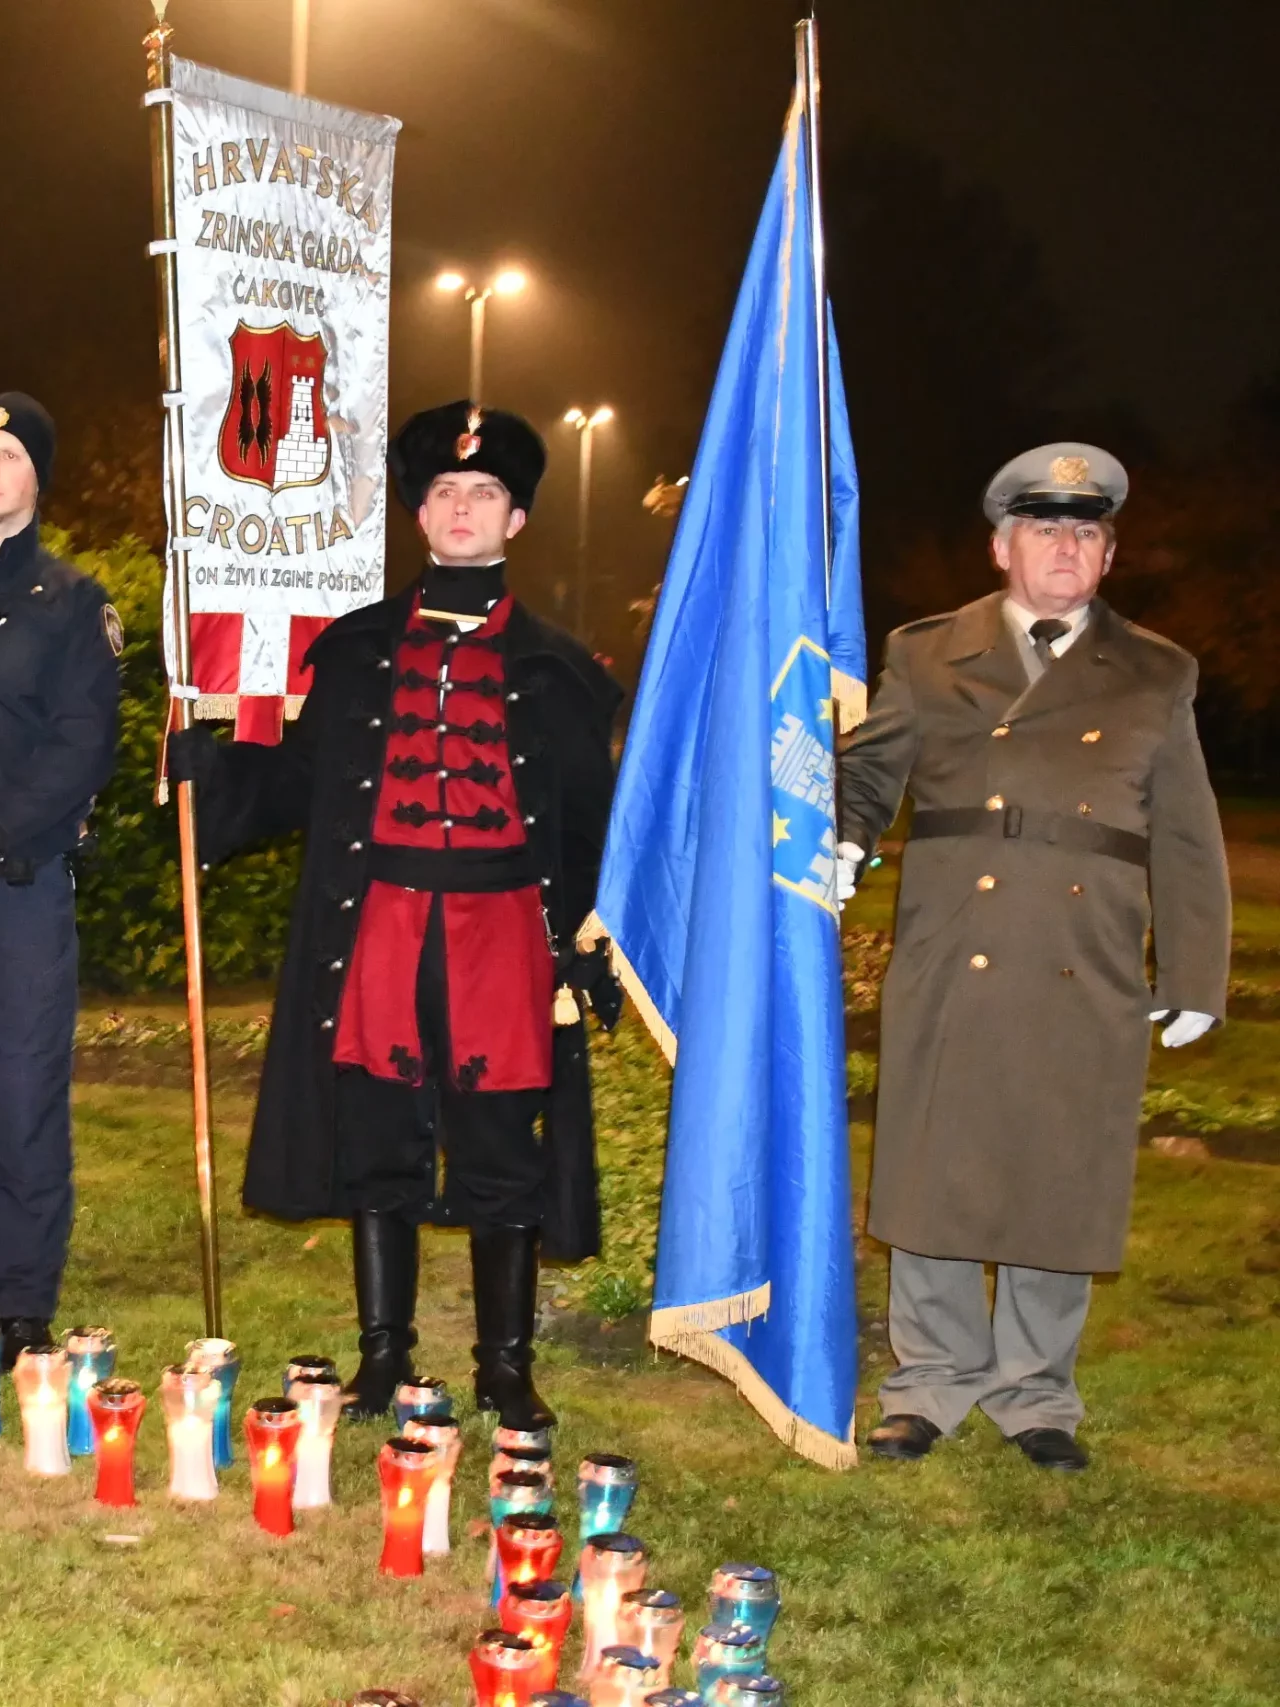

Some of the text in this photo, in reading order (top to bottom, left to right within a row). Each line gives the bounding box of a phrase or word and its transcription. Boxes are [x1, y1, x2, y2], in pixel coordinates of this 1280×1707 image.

[192, 138, 377, 233] HRVATSKA
[195, 210, 366, 275] ZRINSKA GARDA
[232, 269, 326, 317] ČAKOVEC
[185, 495, 354, 556] CROATIA
[195, 566, 218, 586] ON
[223, 562, 256, 587] ŽIVI
[270, 568, 314, 589] ZGINE
[317, 569, 372, 593] POŠTENO
